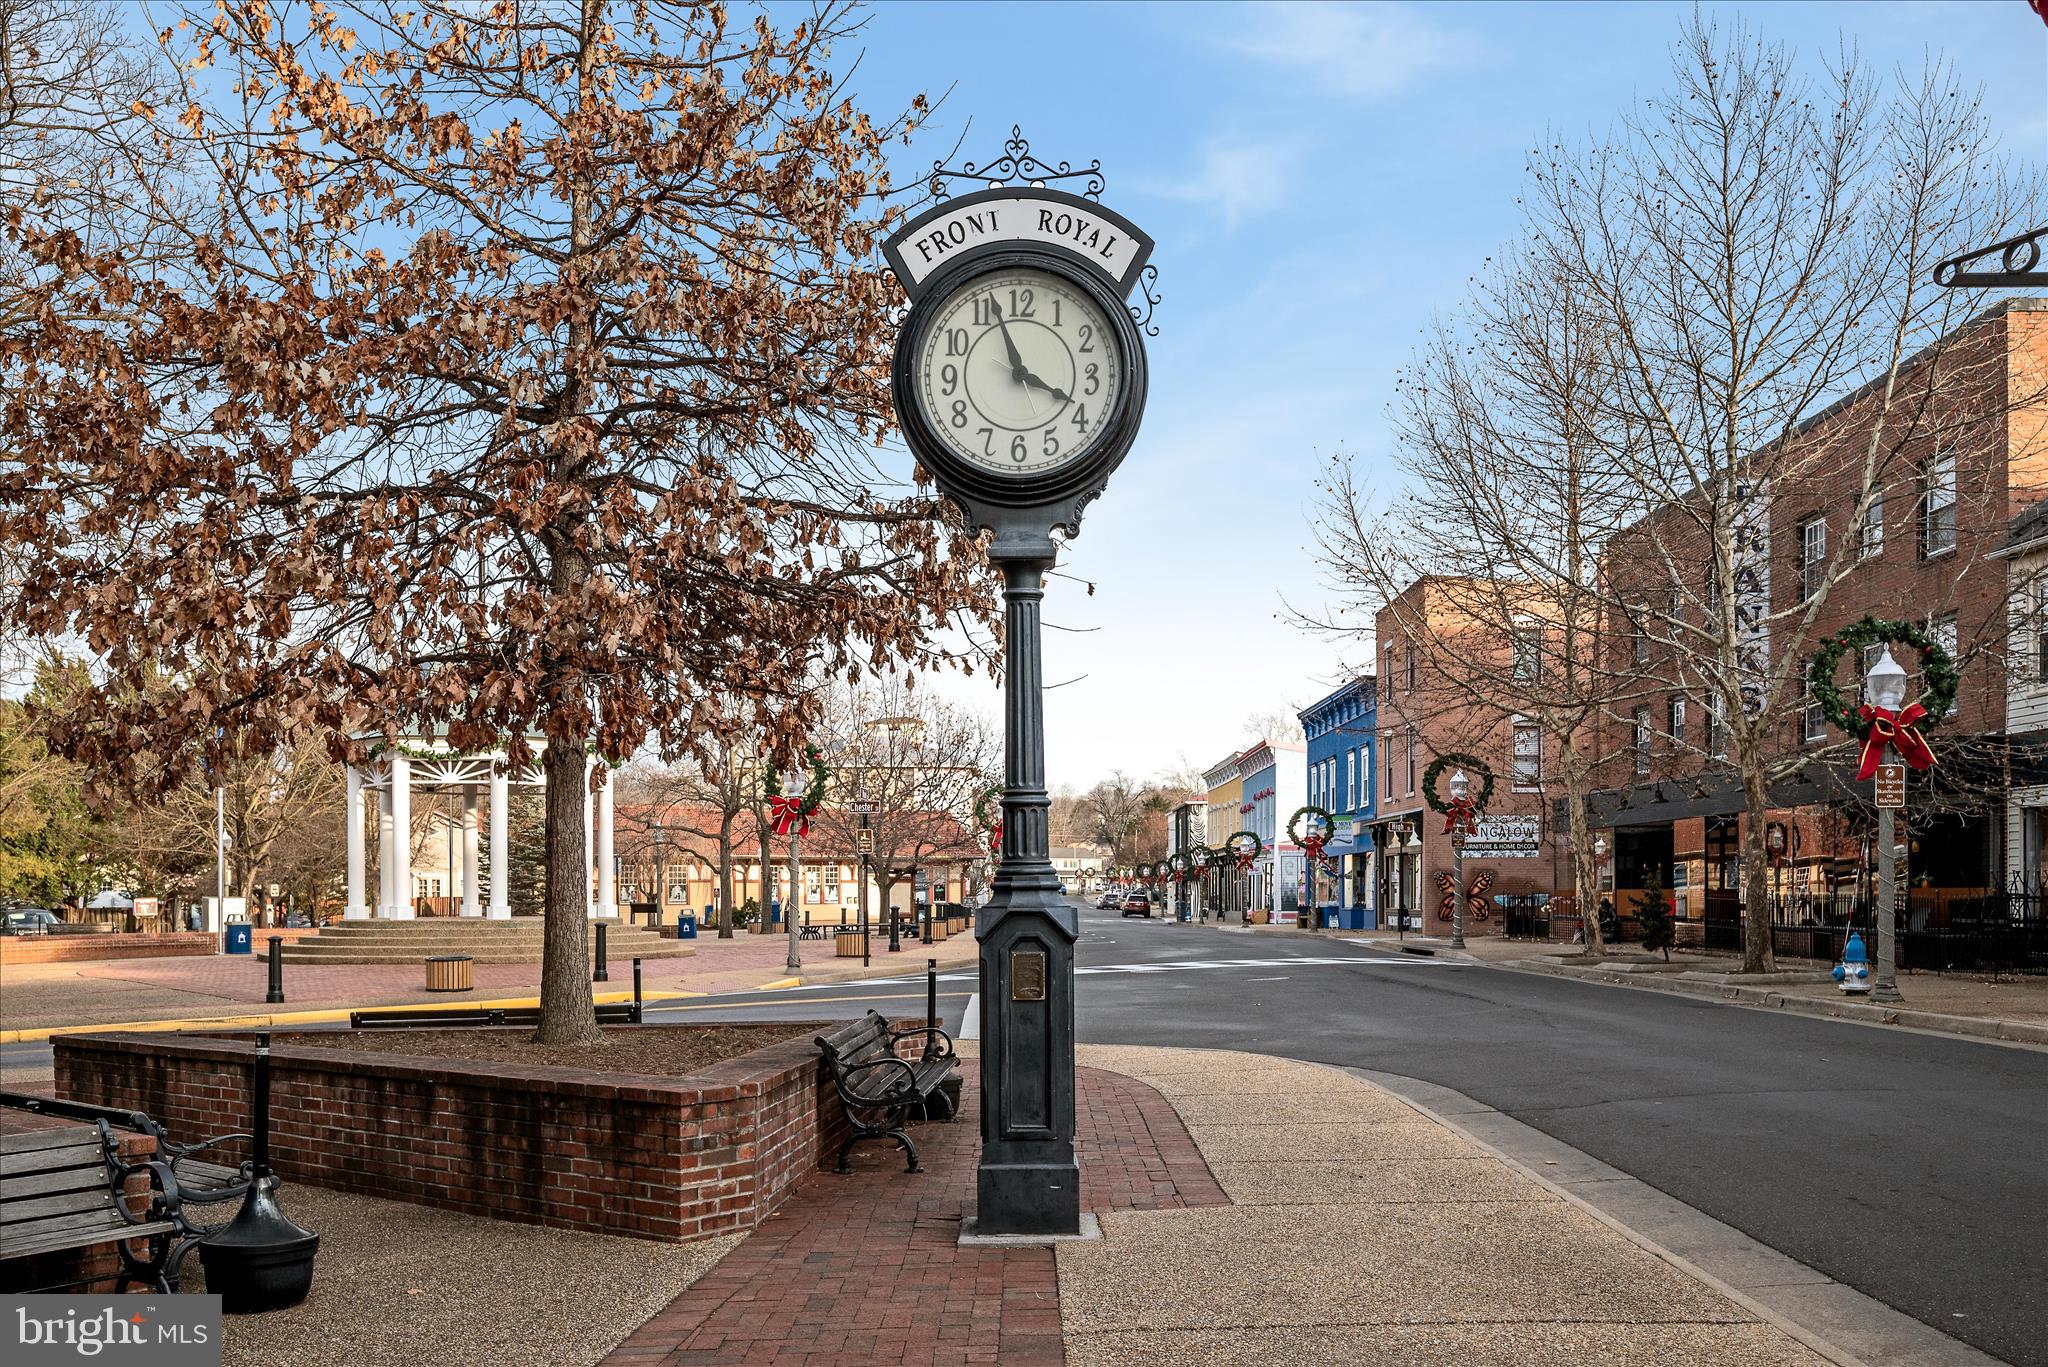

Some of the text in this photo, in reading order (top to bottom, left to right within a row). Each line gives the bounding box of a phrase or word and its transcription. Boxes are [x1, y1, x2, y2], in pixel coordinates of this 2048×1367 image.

[914, 208, 1117, 263] FRONT ROYAL
[971, 298, 992, 326] 11
[1009, 289, 1036, 318] 12
[1052, 300, 1063, 327] 1
[945, 328, 969, 356] 10
[1078, 324, 1095, 353] 2
[941, 364, 958, 396] 9
[1084, 362, 1100, 395] 3
[951, 400, 968, 428] 8
[1071, 403, 1089, 433] 4
[976, 428, 996, 456] 7
[1010, 435, 1027, 462] 6
[1043, 426, 1060, 456] 5
[850, 802, 873, 811] Chester
[1466, 826, 1535, 838] NGALOW
